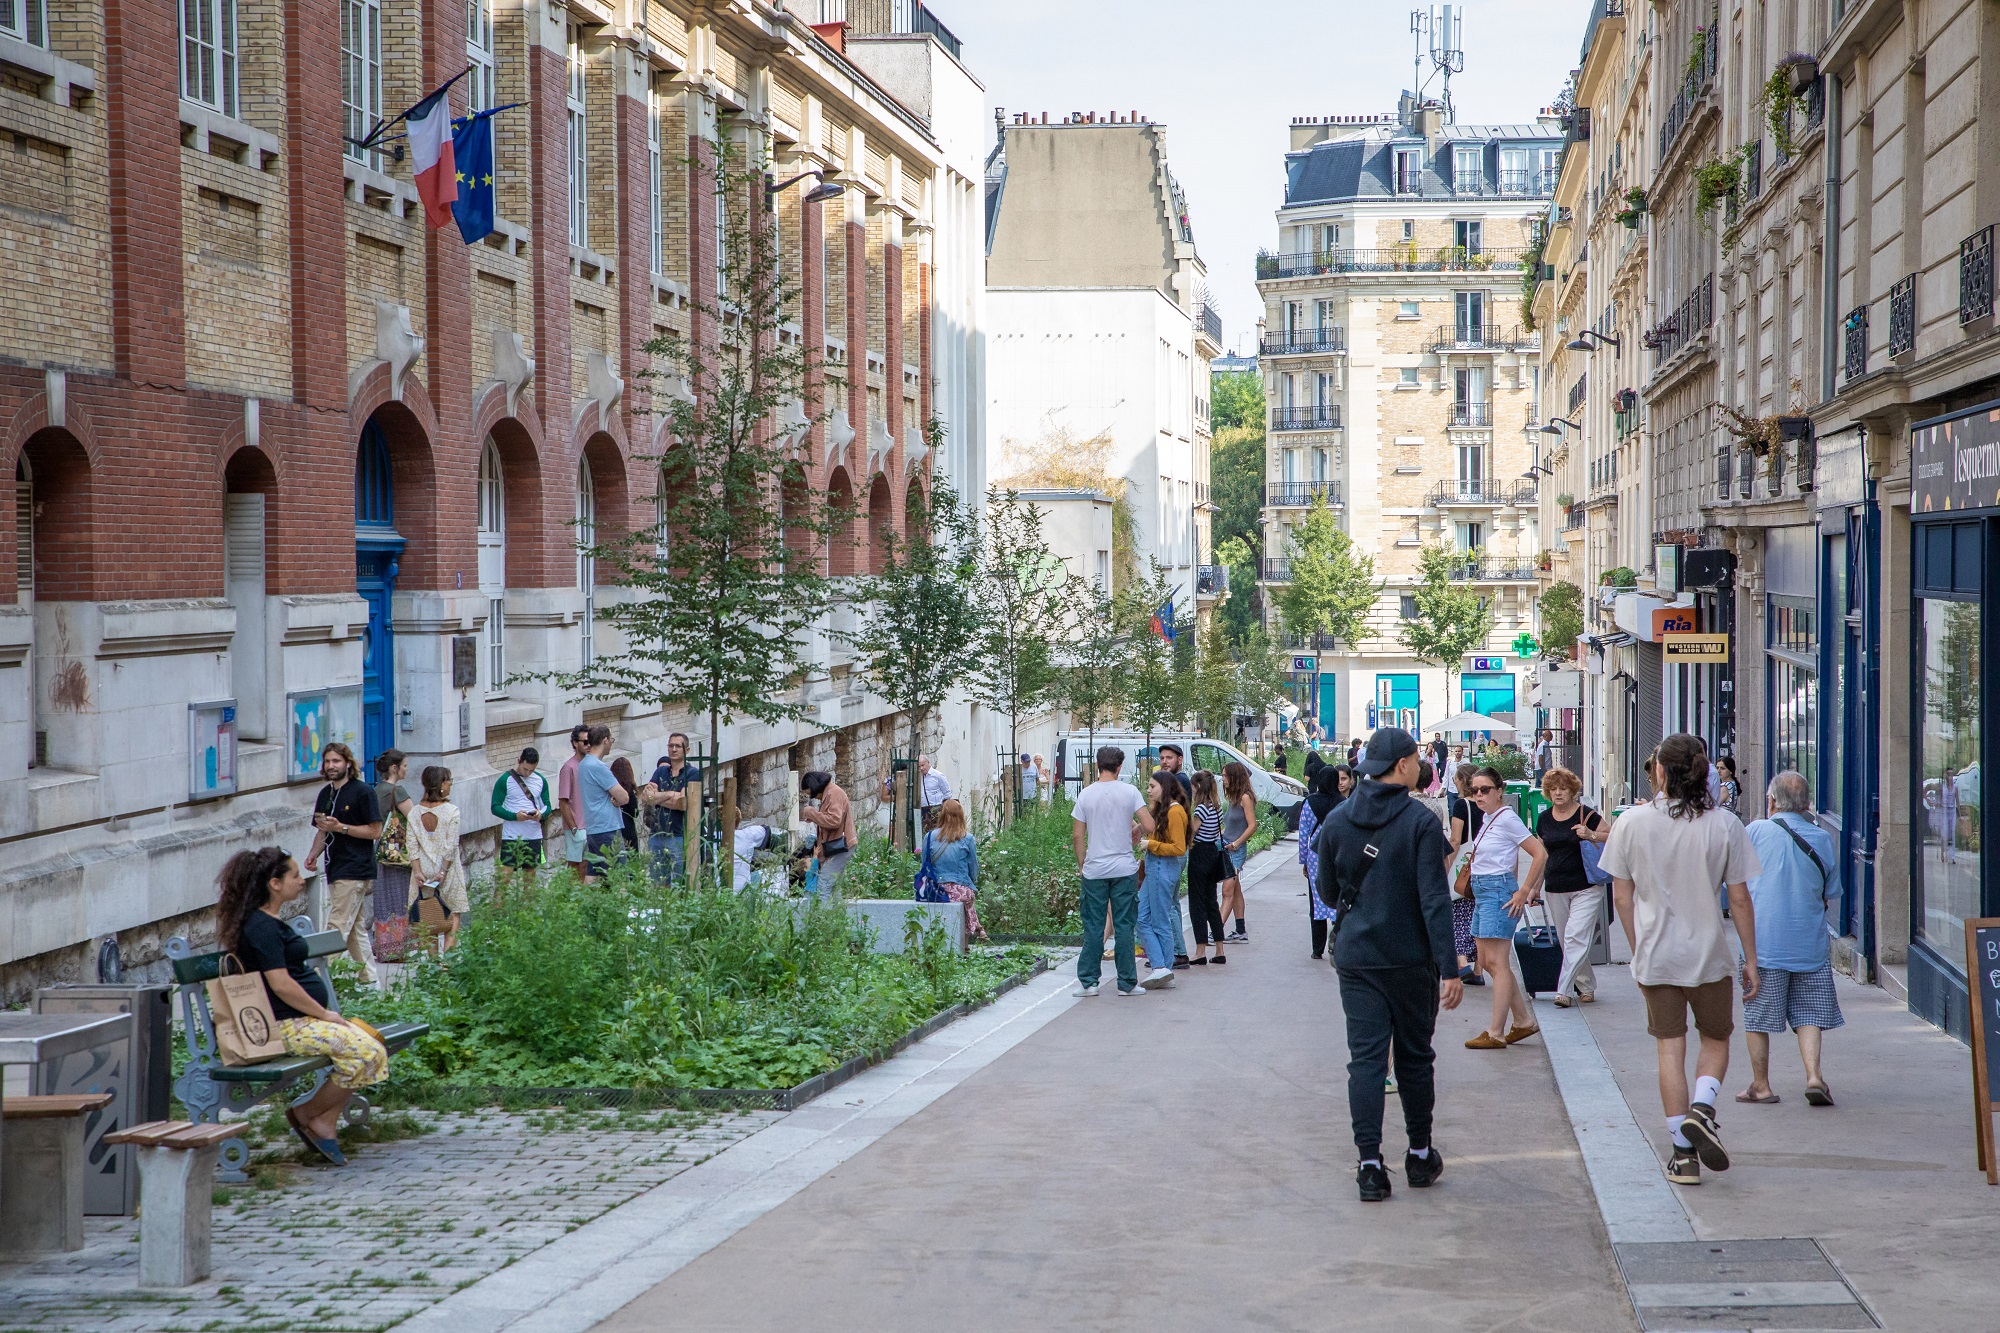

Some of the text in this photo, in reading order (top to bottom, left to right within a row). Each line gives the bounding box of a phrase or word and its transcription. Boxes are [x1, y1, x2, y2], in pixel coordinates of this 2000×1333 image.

[1663, 615, 1692, 631] Ria
[1295, 659, 1313, 669] CIC
[1477, 659, 1500, 669] CIC
